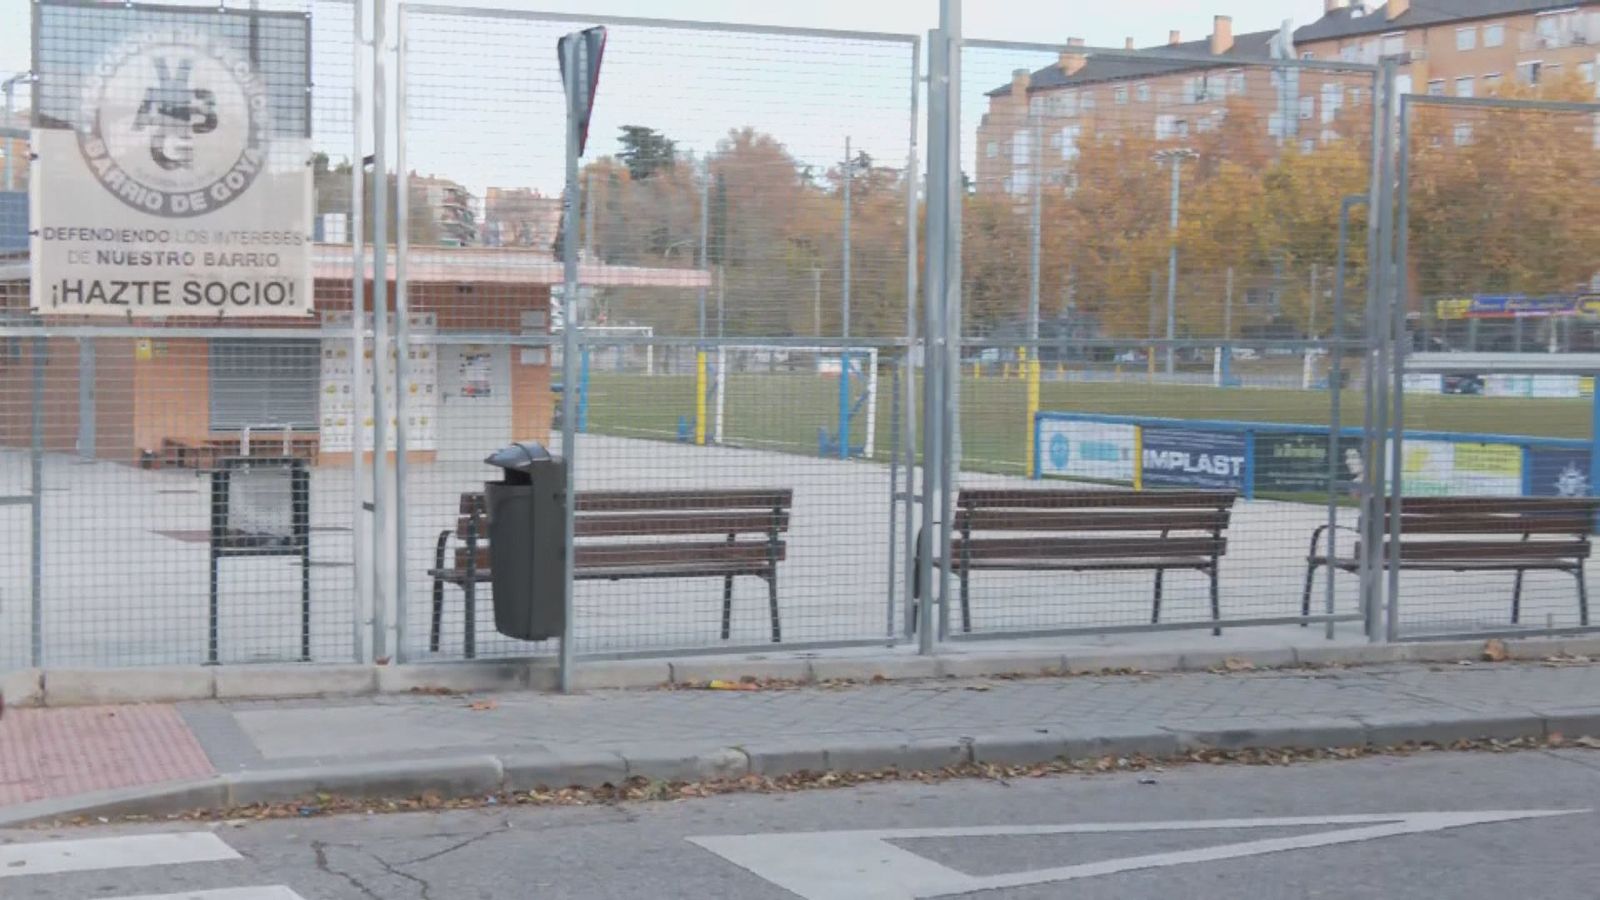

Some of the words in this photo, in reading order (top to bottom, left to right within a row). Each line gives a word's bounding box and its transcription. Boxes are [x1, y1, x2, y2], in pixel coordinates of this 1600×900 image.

[83, 136, 163, 211] BARRIO
[170, 192, 207, 213] DE
[44, 227, 170, 243] DEFENDIENDO
[175, 231, 207, 244] LOS
[214, 231, 303, 246] INTERESES
[67, 250, 90, 265] DE
[96, 250, 195, 266] NUESTRO
[203, 252, 280, 268] BARRIO
[52, 279, 171, 308] ¡HAZTE
[182, 280, 296, 306] SOCIO!
[1143, 448, 1245, 476] IMPLAST
